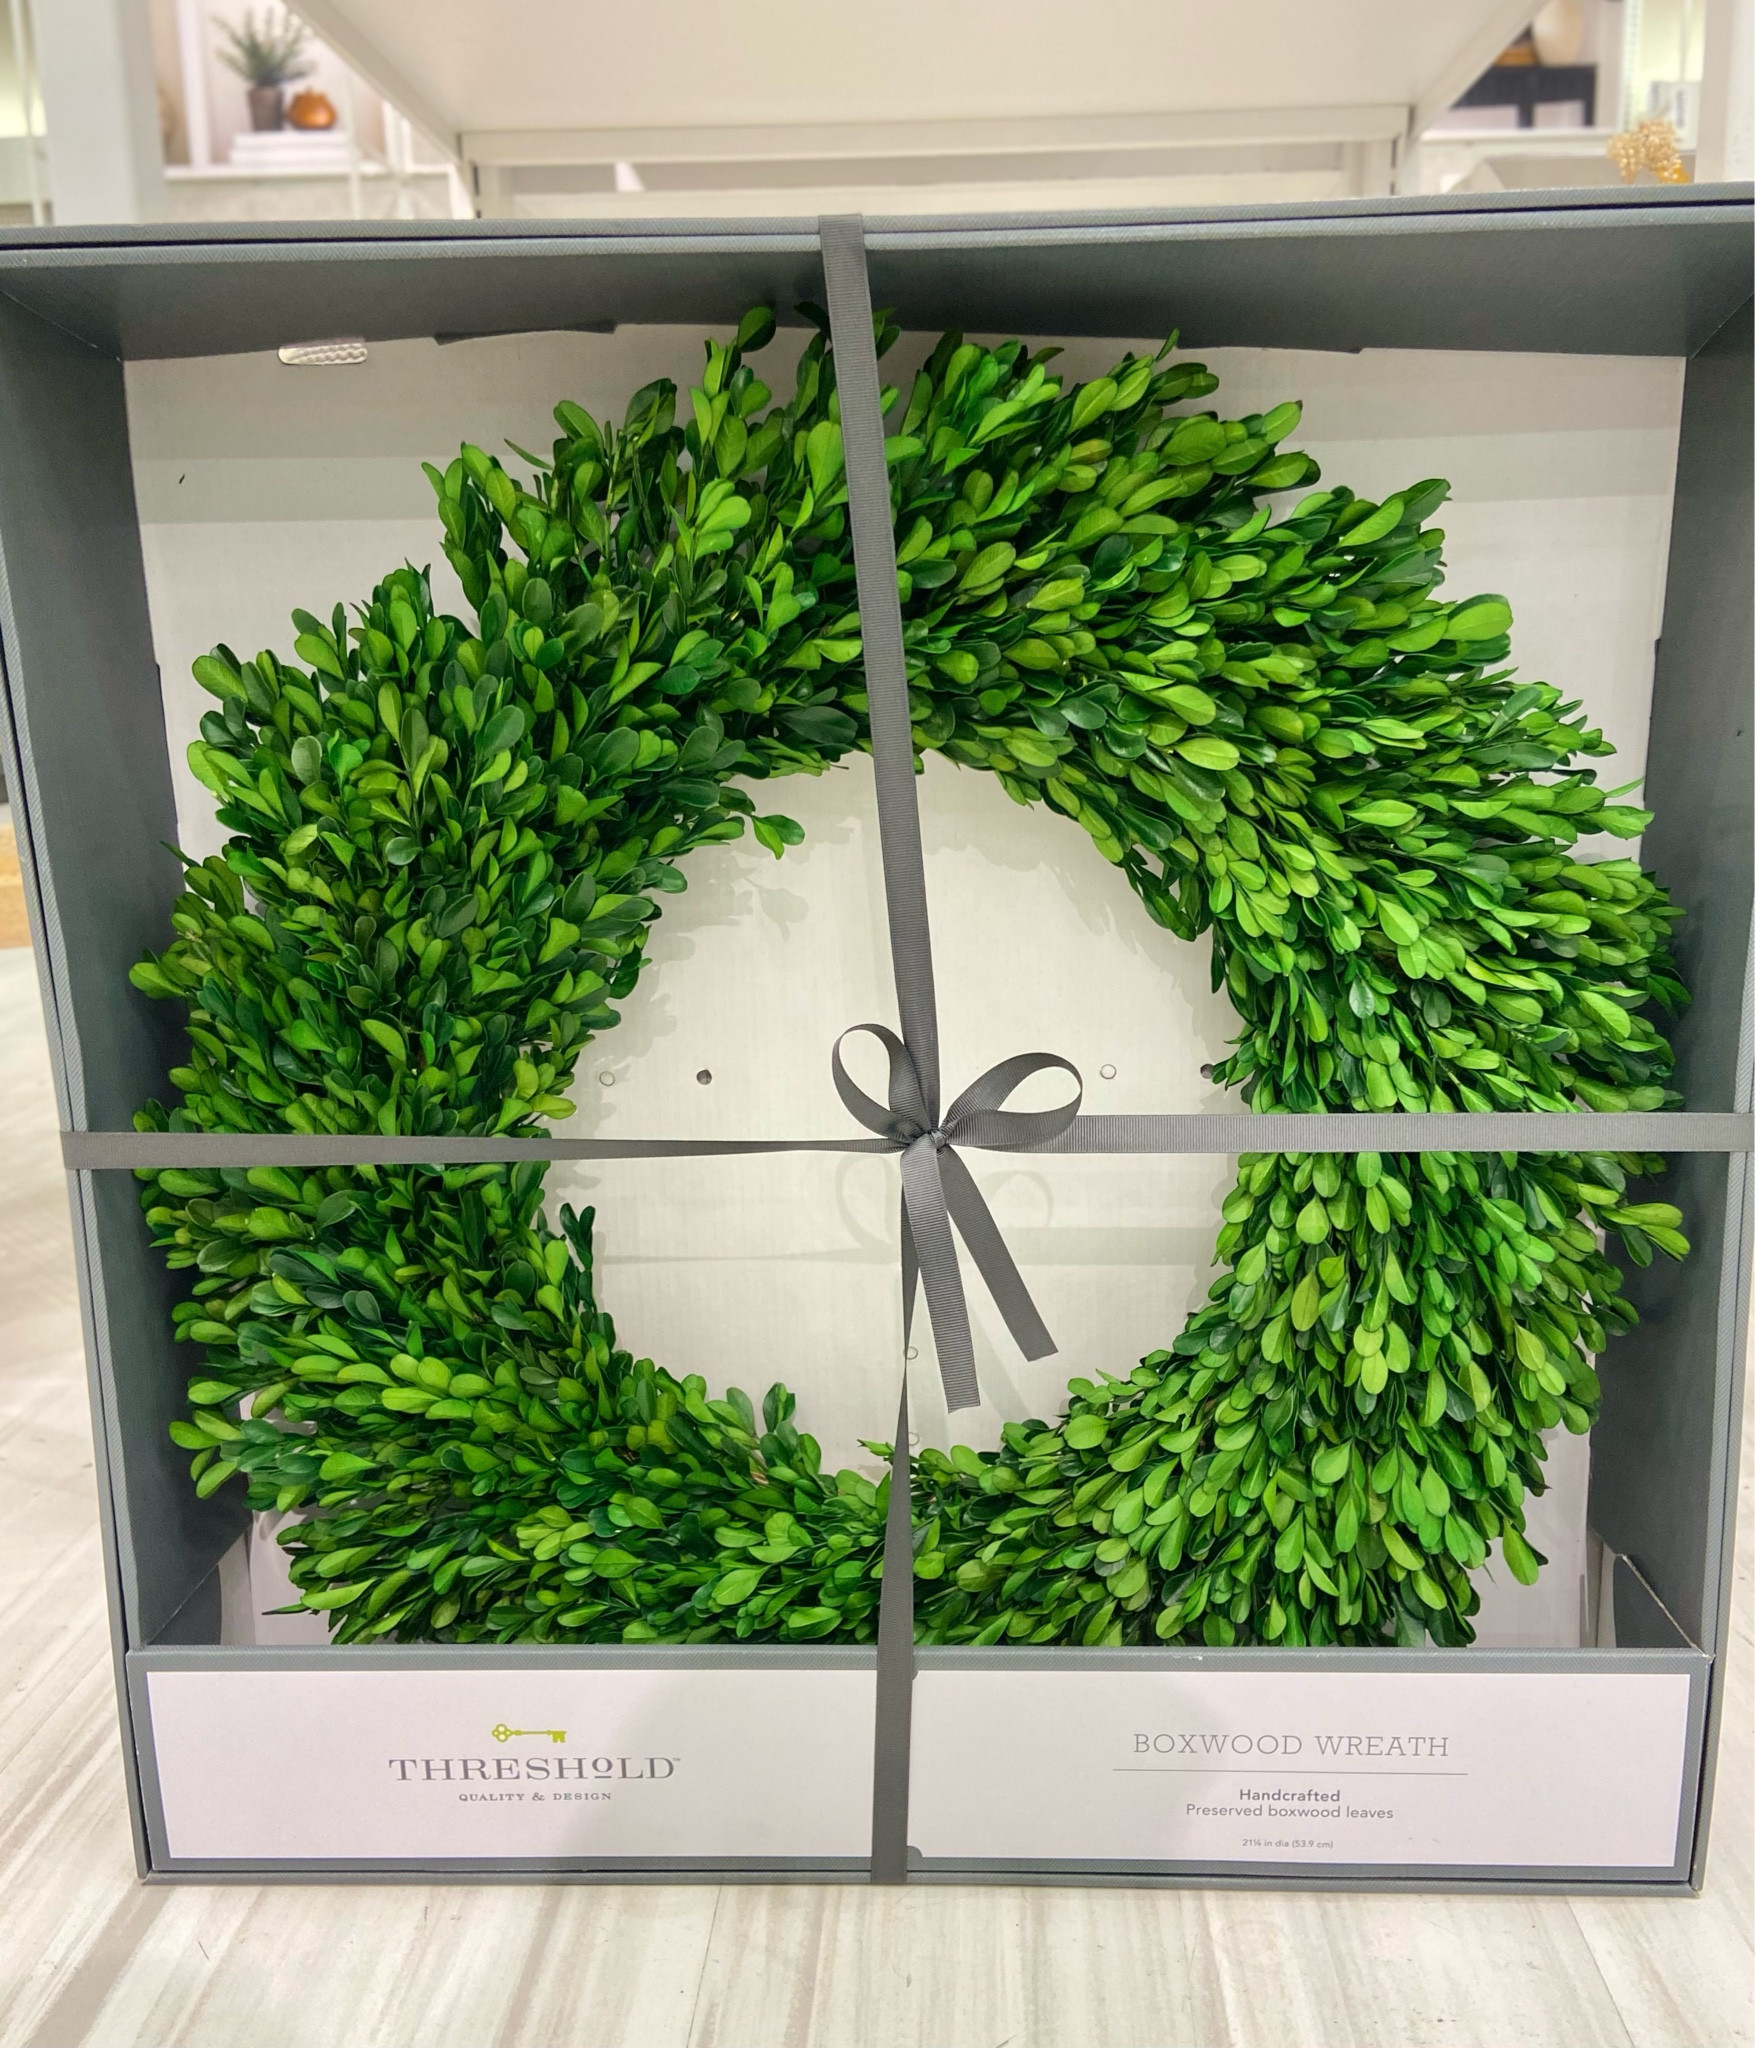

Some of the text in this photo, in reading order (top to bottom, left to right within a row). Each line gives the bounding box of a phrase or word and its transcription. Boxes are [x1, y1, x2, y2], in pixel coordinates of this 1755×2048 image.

[1133, 1733, 1449, 1757] BOXWOOD WREATH
[458, 1791, 612, 1802] QUALITY & DESIGN
[1239, 1788, 1341, 1802] Handcrafted
[1186, 1803, 1394, 1819] Preserved boxwood leaves
[1263, 1839, 1273, 1847] in
[1274, 1839, 1290, 1848] dia
[1291, 1839, 1315, 1849] (53.9
[1316, 1840, 1334, 1849] cm)
